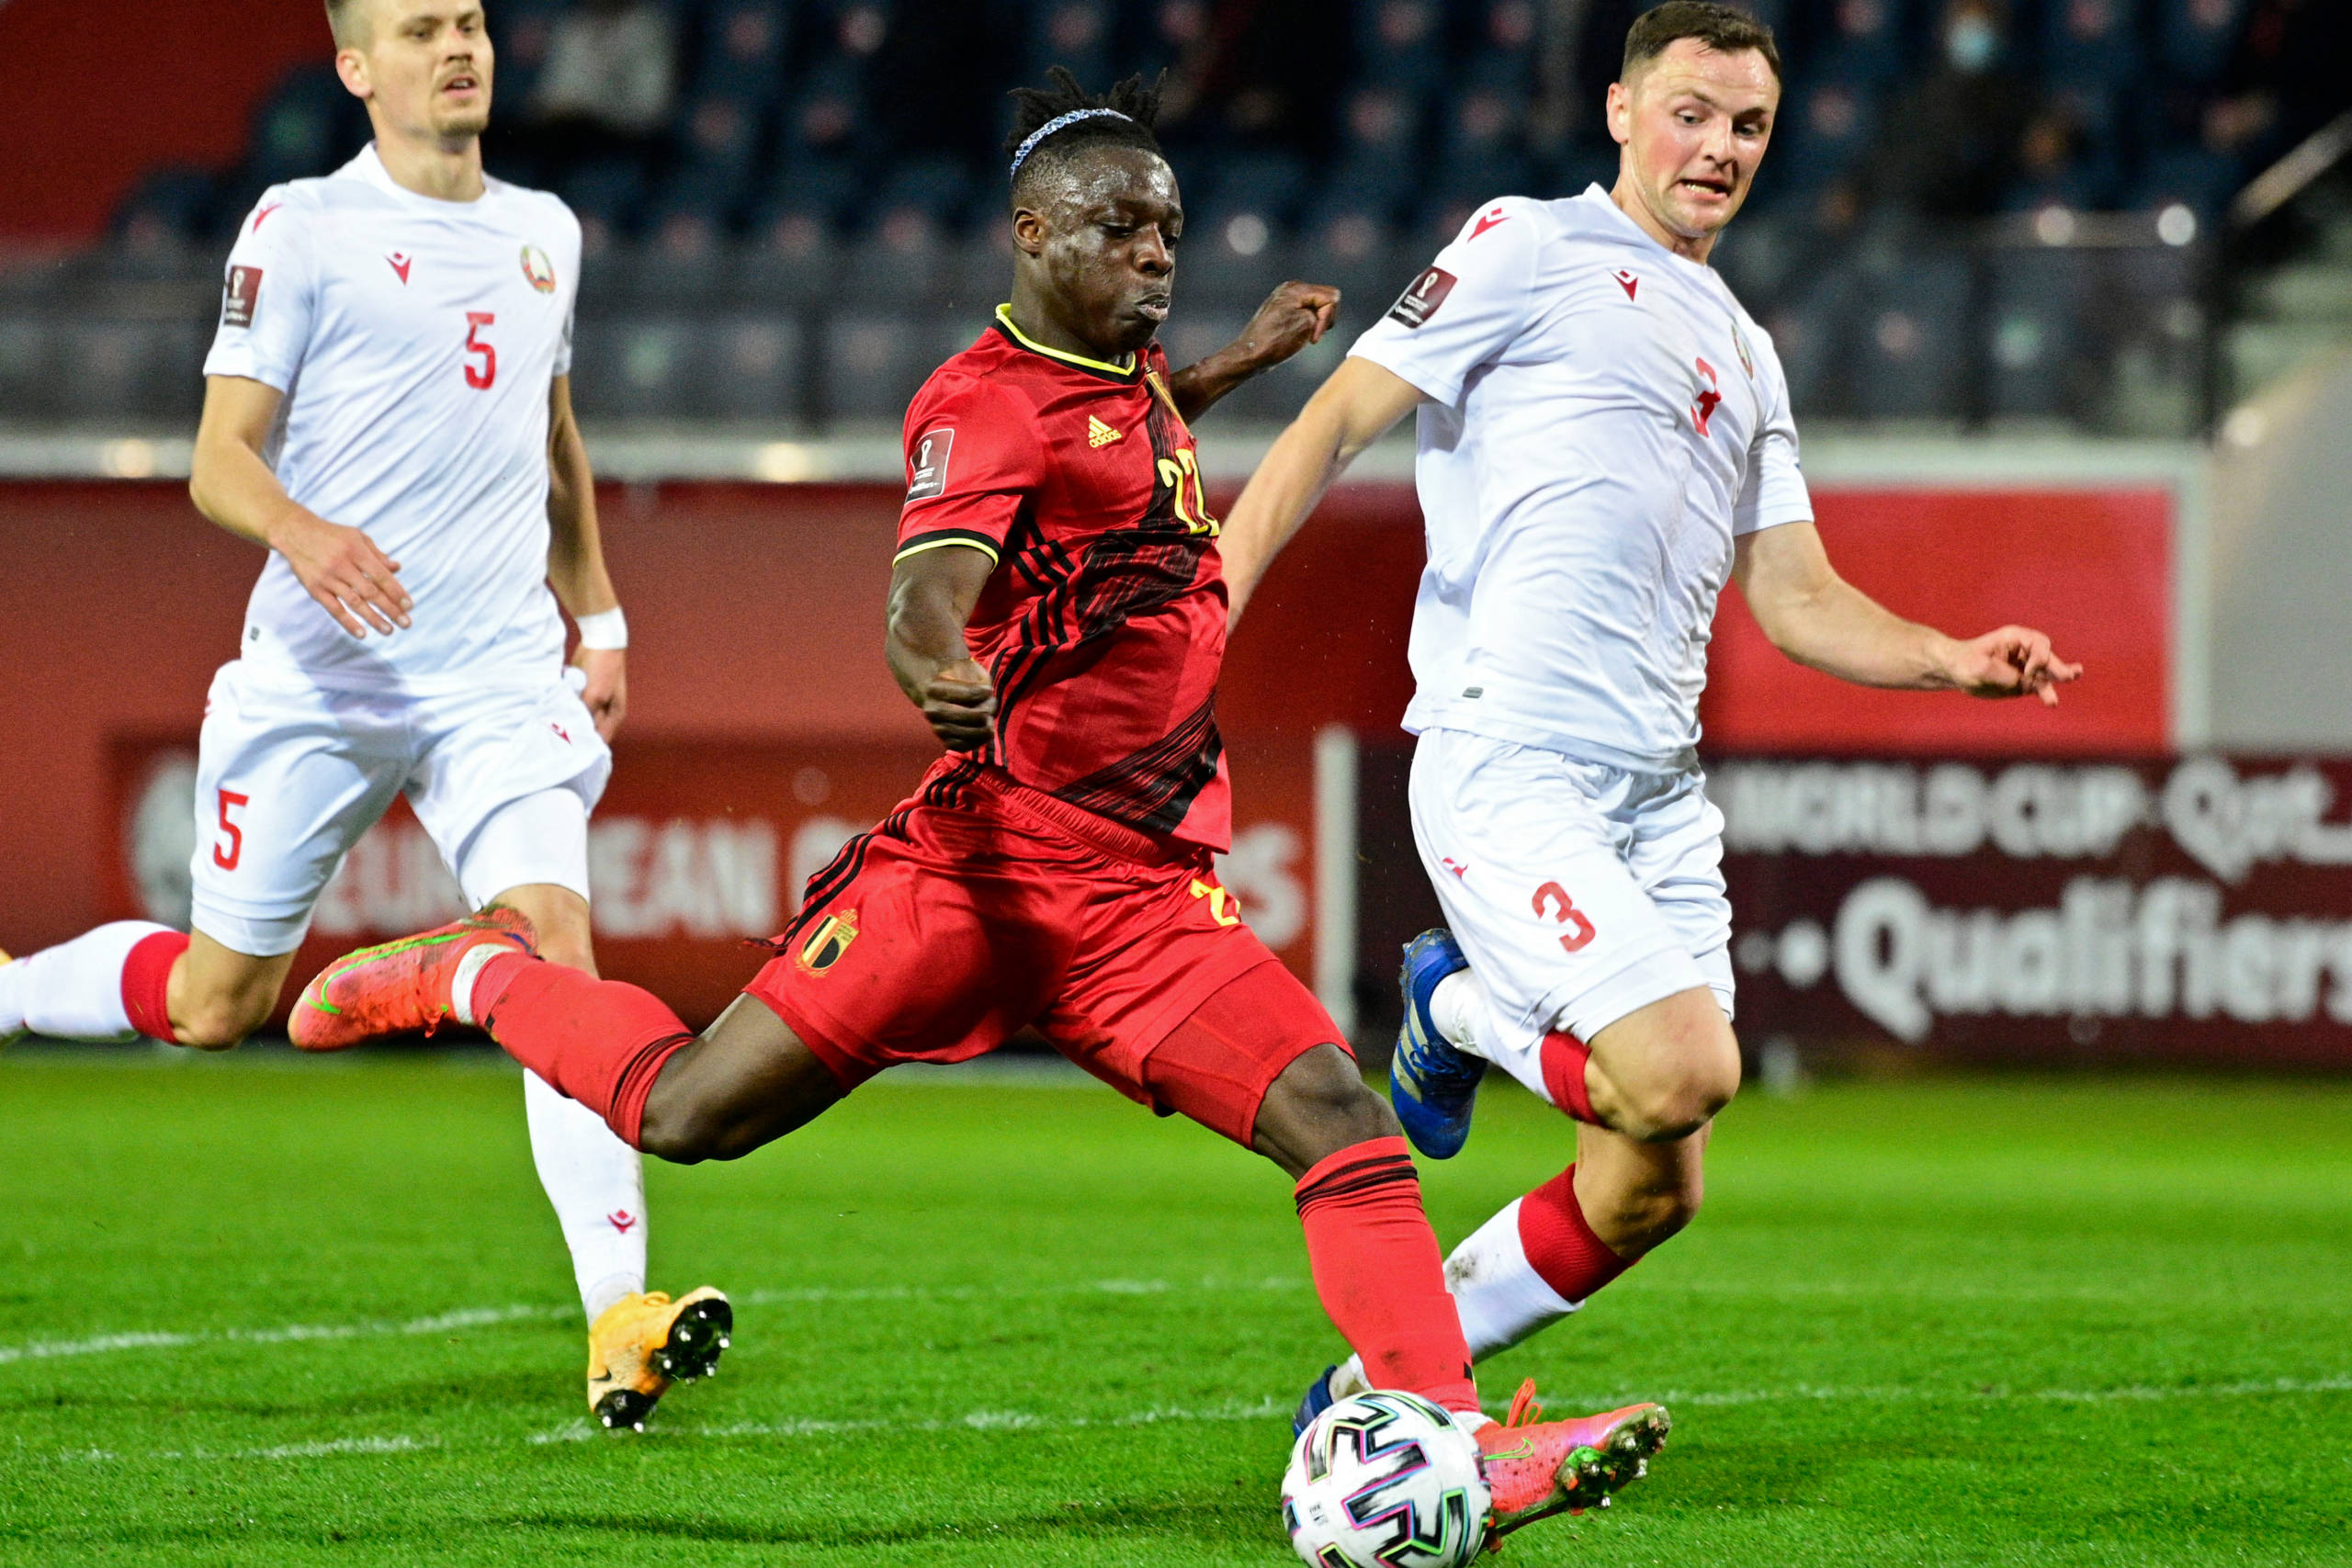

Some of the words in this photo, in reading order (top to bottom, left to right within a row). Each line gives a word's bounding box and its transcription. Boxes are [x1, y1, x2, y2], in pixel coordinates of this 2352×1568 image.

[464, 311, 496, 390] 5
[1690, 356, 1722, 438] 3
[1089, 429, 1123, 448] adidas
[1158, 448, 1220, 536] 22
[213, 788, 249, 872] 5
[1986, 764, 2143, 855] CUP
[1190, 878, 1240, 927] 2
[1532, 881, 1596, 953] 3
